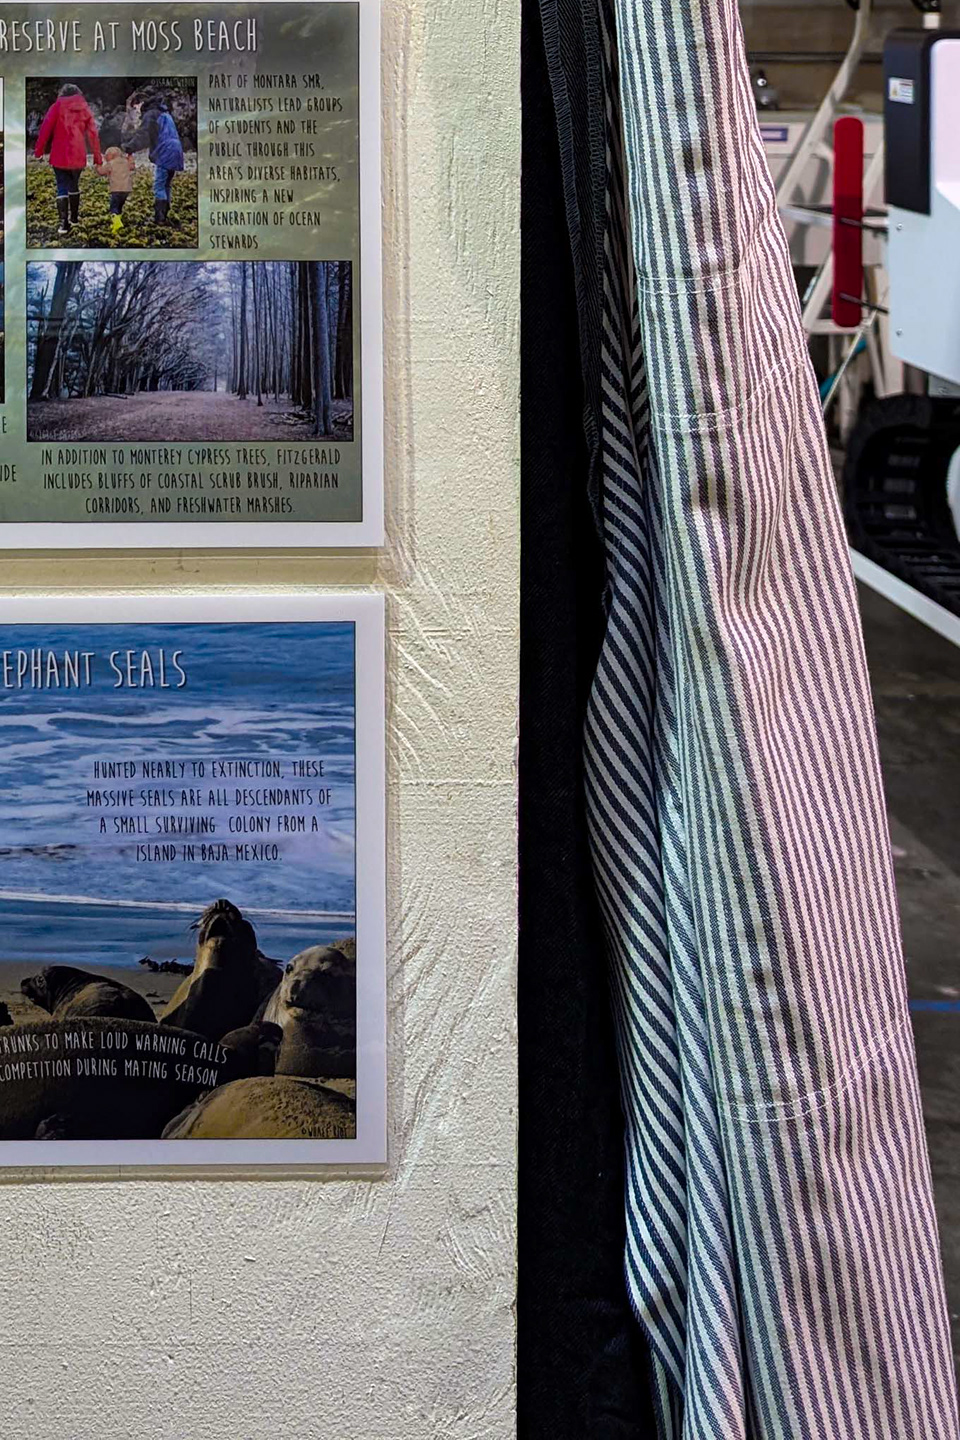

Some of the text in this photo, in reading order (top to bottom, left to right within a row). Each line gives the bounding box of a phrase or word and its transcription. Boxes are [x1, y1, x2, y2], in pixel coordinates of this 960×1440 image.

[93, 21, 120, 51] AT
[132, 21, 182, 51] MOSS
[194, 19, 258, 52] BEACH
[41, 448, 340, 466] IN ADDITION TO MONTEREY CYPRESS TREES, FITZGERALD
[44, 472, 339, 490] INCLUDES BLUFFS OF COASTAL SCRUB BRUSH, RIPARIAN
[85, 497, 144, 515] CORRIDORS,
[150, 497, 171, 513] AND
[177, 496, 242, 513] FRESHWATER
[109, 648, 187, 688] SEALS
[44, 1033, 59, 1050] TO
[64, 1031, 94, 1050] MAKE
[100, 1031, 129, 1050] LOUD
[135, 1033, 187, 1056] WARNING
[193, 1040, 228, 1064] CALLS
[76, 1058, 117, 1076] DURING
[124, 1059, 167, 1079] MATING
[175, 1063, 219, 1087] SEASON.
